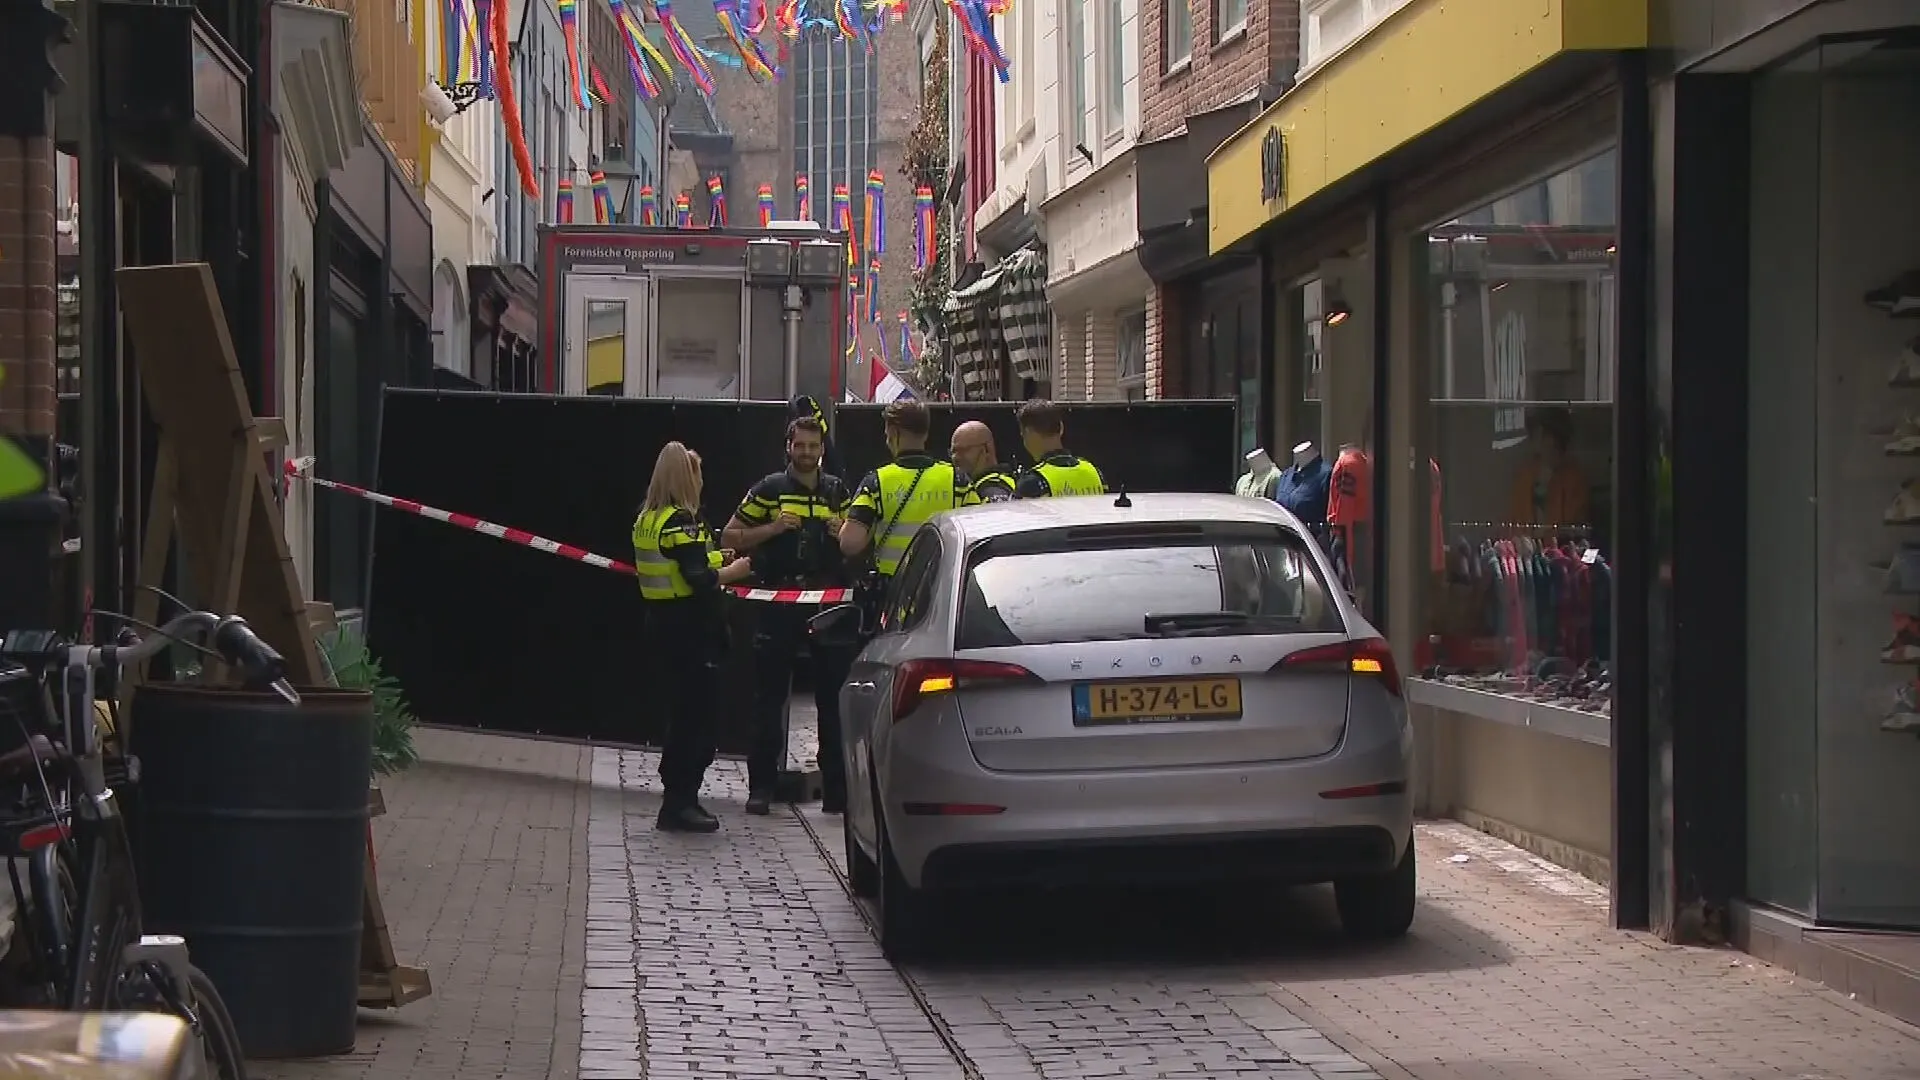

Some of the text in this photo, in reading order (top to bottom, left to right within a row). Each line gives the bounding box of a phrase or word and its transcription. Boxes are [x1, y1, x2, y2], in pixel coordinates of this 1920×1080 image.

[563, 247, 675, 260] Forensische Opsporing
[886, 490, 949, 503] PLITIE
[1101, 684, 1228, 713] H-374-LG
[975, 726, 1023, 736] SCALA
